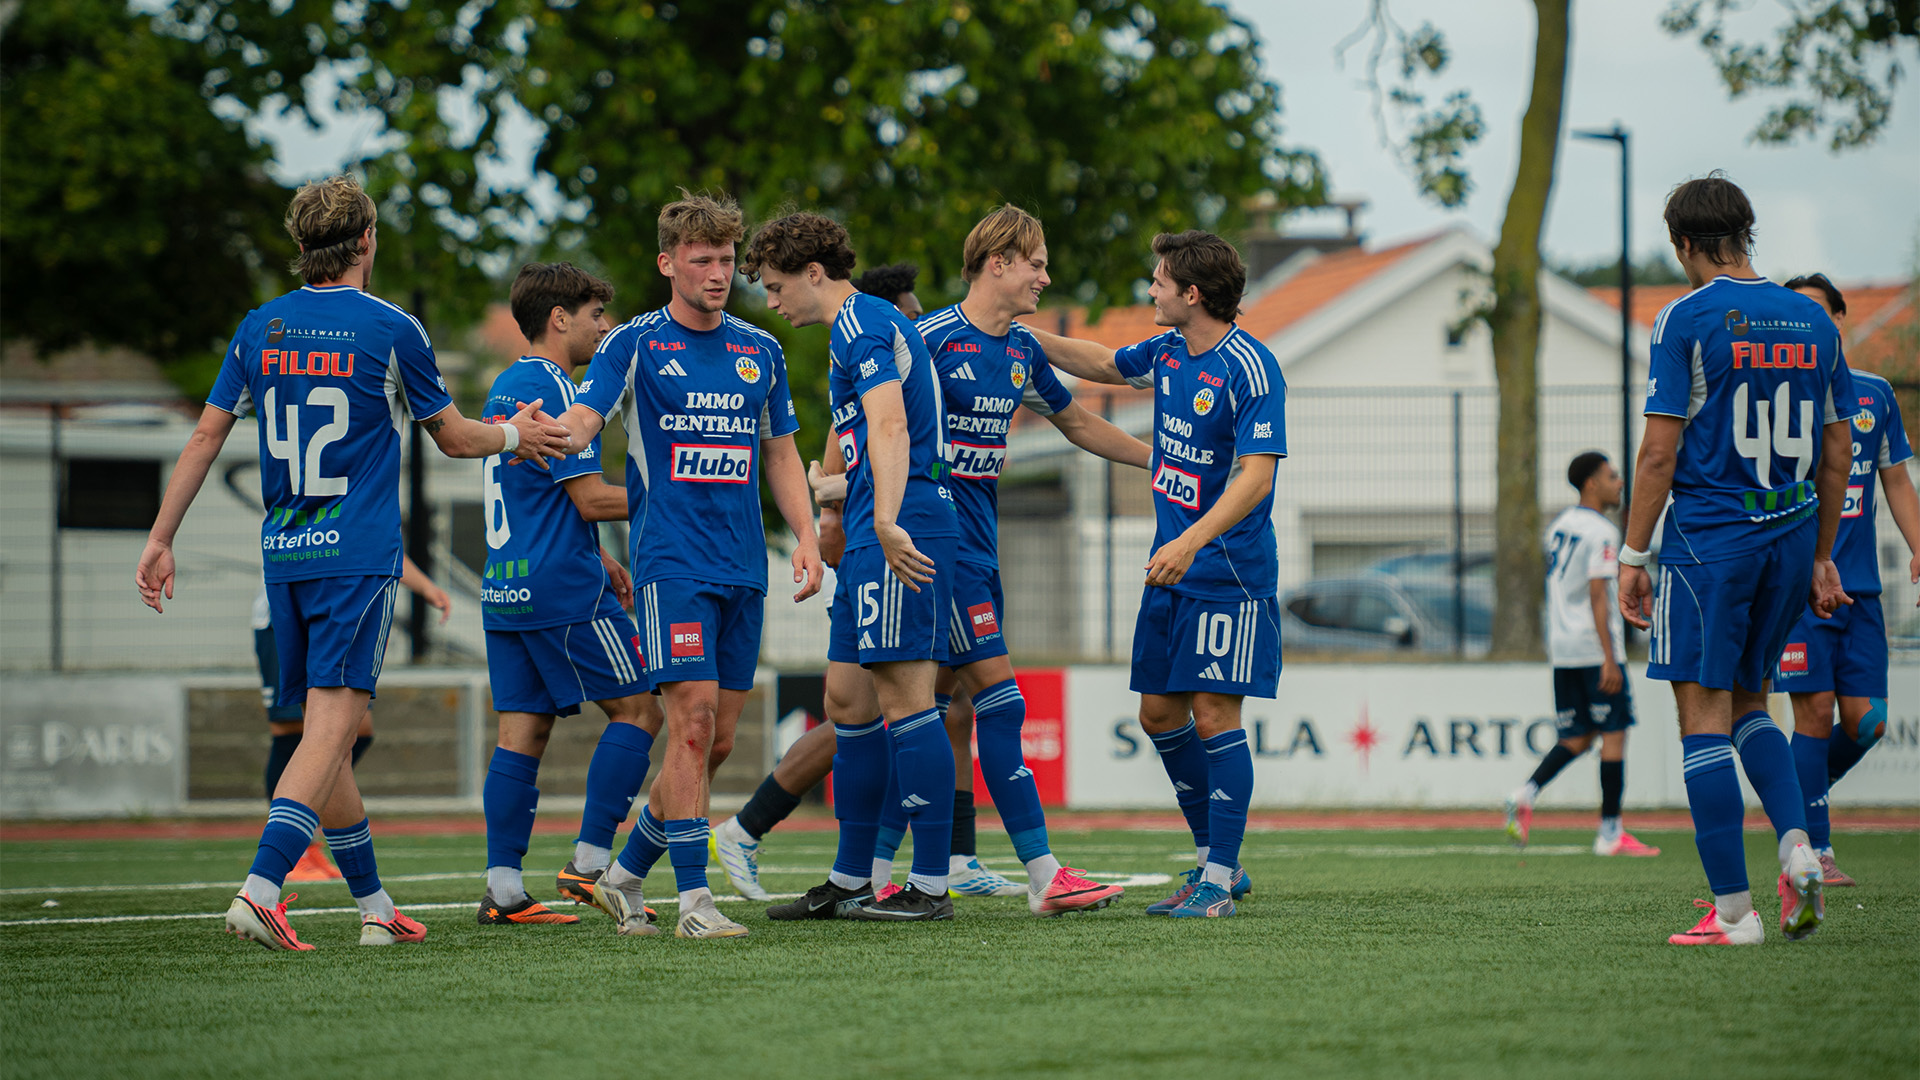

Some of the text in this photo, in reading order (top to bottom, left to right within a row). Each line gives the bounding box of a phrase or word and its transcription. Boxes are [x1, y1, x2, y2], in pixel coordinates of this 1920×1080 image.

[649, 340, 686, 350] FILOU
[726, 342, 760, 354] FILOU
[947, 342, 981, 353] FILOU
[262, 349, 354, 377] FILOU
[1731, 341, 1817, 369] FILOU
[860, 357, 875, 373] bet
[862, 364, 879, 379] FIRST
[685, 392, 745, 410] IMMO
[972, 396, 1014, 413] IMMO
[1253, 431, 1273, 439] FIRST
[1254, 421, 1271, 432] bet
[264, 386, 350, 496] 42
[1732, 381, 1815, 490] 44
[677, 451, 748, 478] Hubo
[263, 527, 340, 550] exterioo
[858, 581, 880, 628] 15
[982, 611, 995, 622] RR
[685, 633, 700, 643] RR
[1196, 612, 1233, 657] 10
